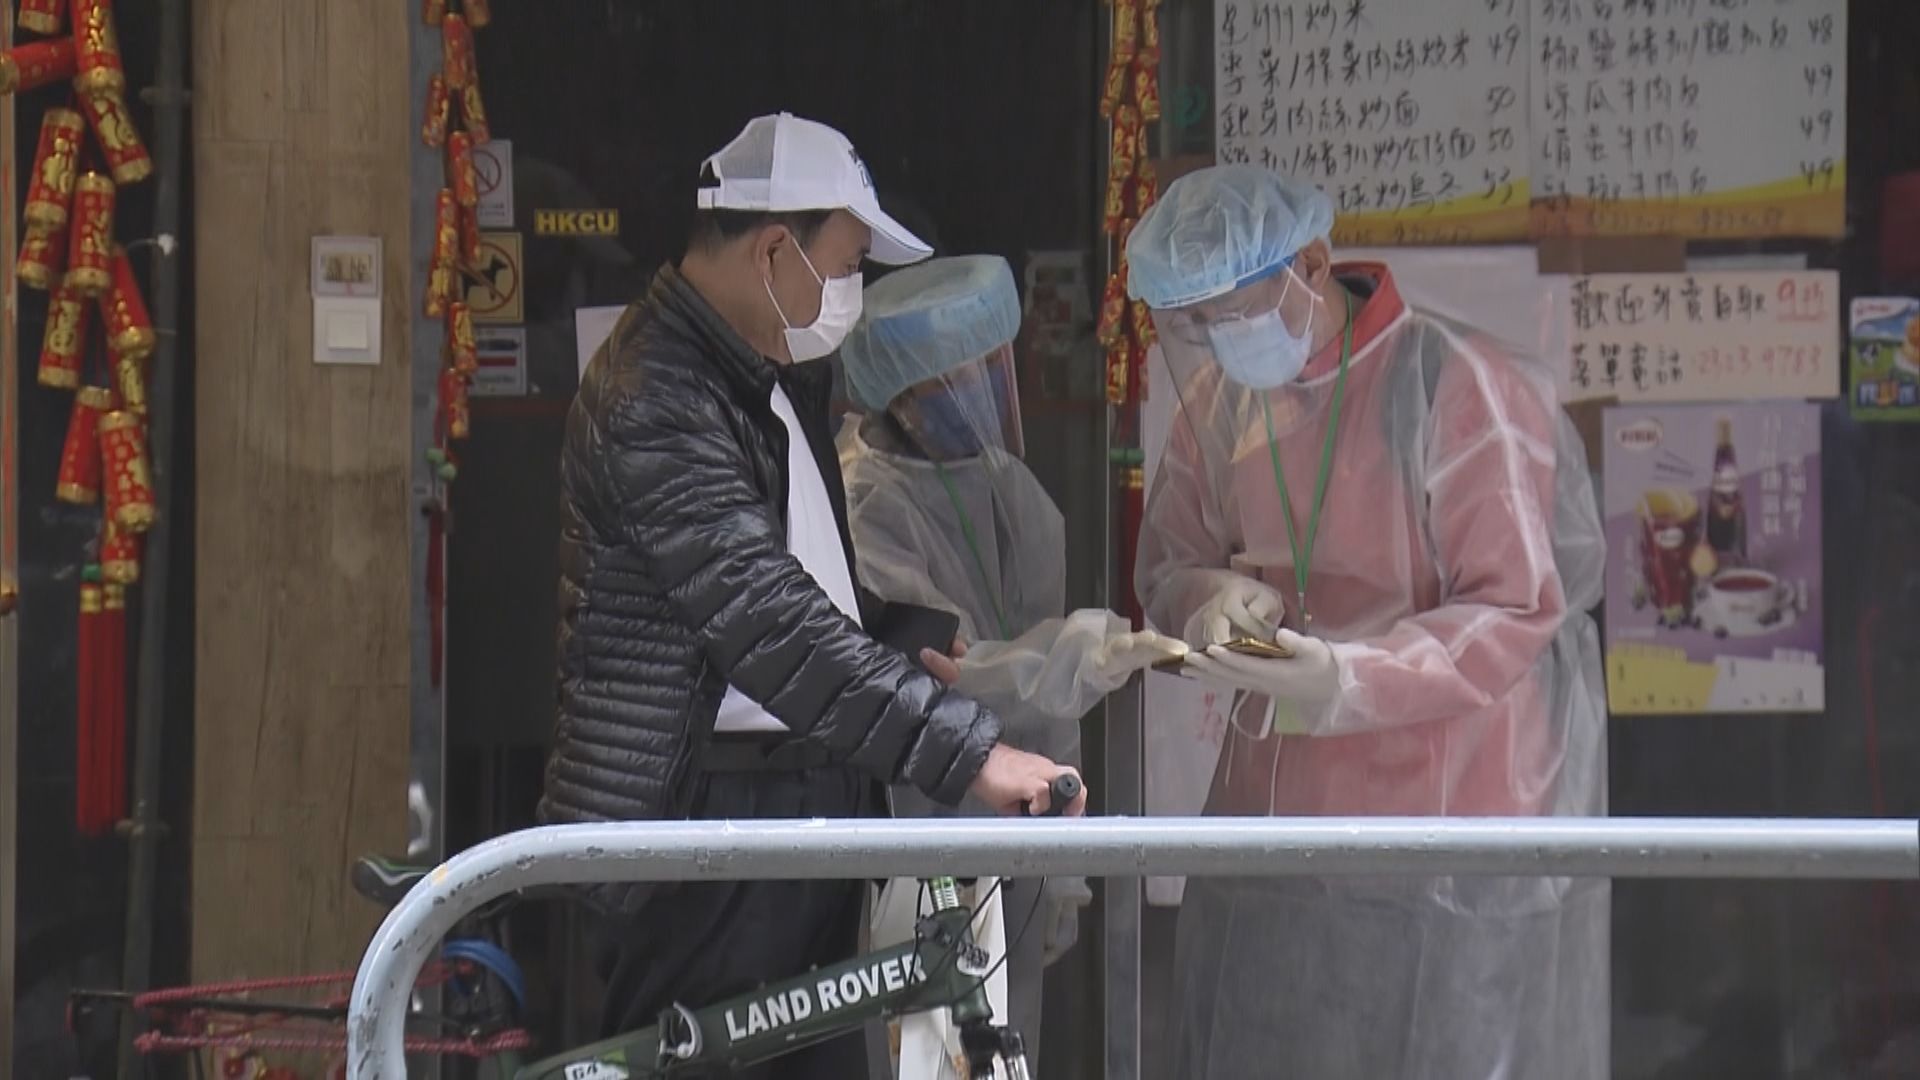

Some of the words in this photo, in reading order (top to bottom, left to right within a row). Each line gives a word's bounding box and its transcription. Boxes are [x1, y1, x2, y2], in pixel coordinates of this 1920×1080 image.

[1488, 23, 1521, 66] 49
[1808, 13, 1834, 46] 48
[1804, 61, 1834, 98] 49
[1487, 84, 1517, 116] 50
[1487, 127, 1515, 153] 50
[1799, 109, 1834, 146] 49
[1799, 156, 1834, 193] 49
[536, 210, 617, 233] HKCU
[725, 988, 814, 1041] LAND
[816, 953, 928, 1013] ROVER
